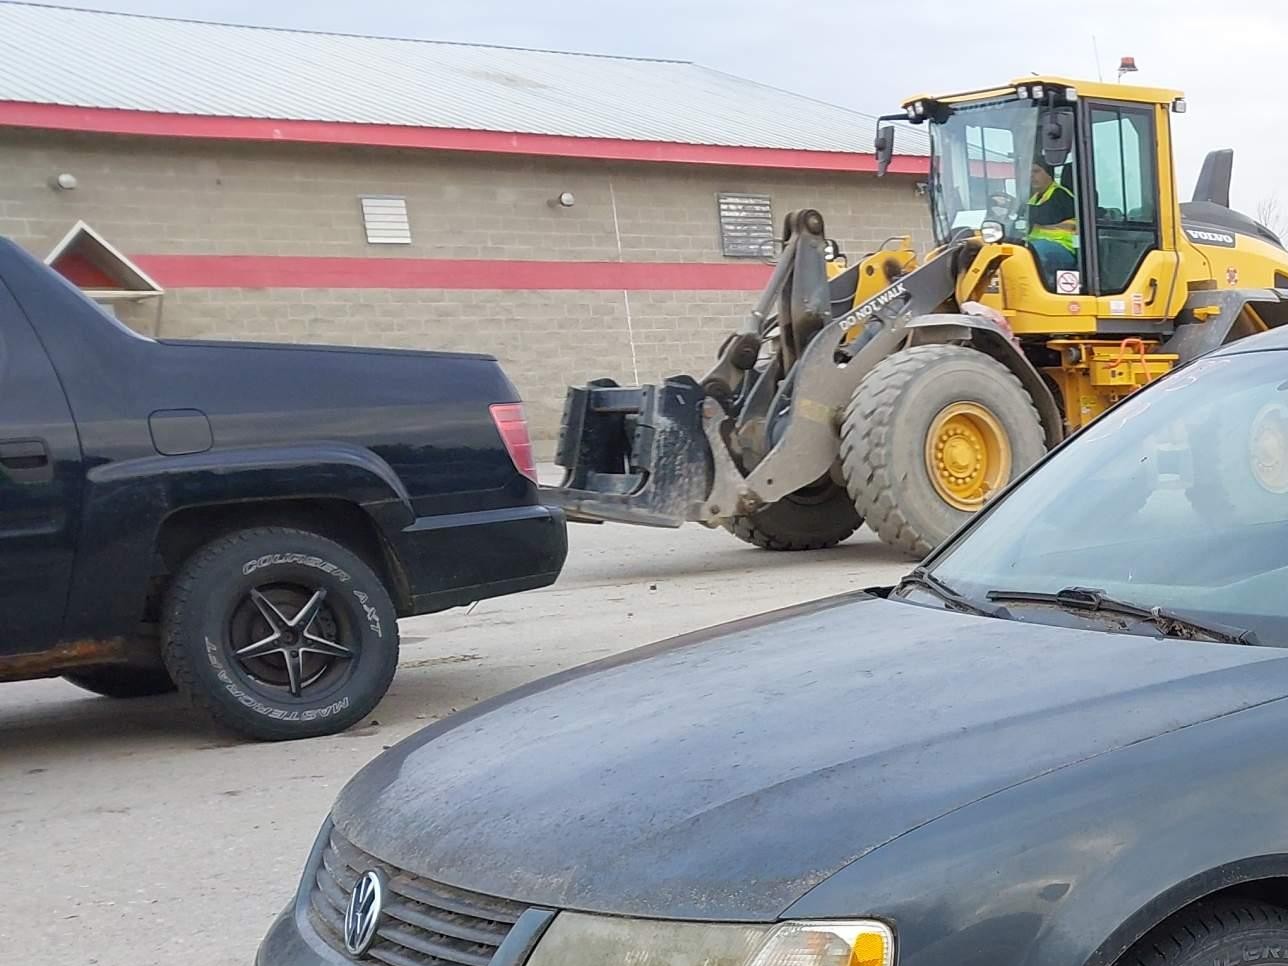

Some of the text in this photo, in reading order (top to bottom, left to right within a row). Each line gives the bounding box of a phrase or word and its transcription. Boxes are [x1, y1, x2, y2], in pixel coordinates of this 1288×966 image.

[1186, 229, 1234, 244] VOLVO
[838, 282, 908, 331] DO NOT WALK
[242, 553, 351, 582] COURSER
[205, 636, 351, 722] MASTERCRAFT
